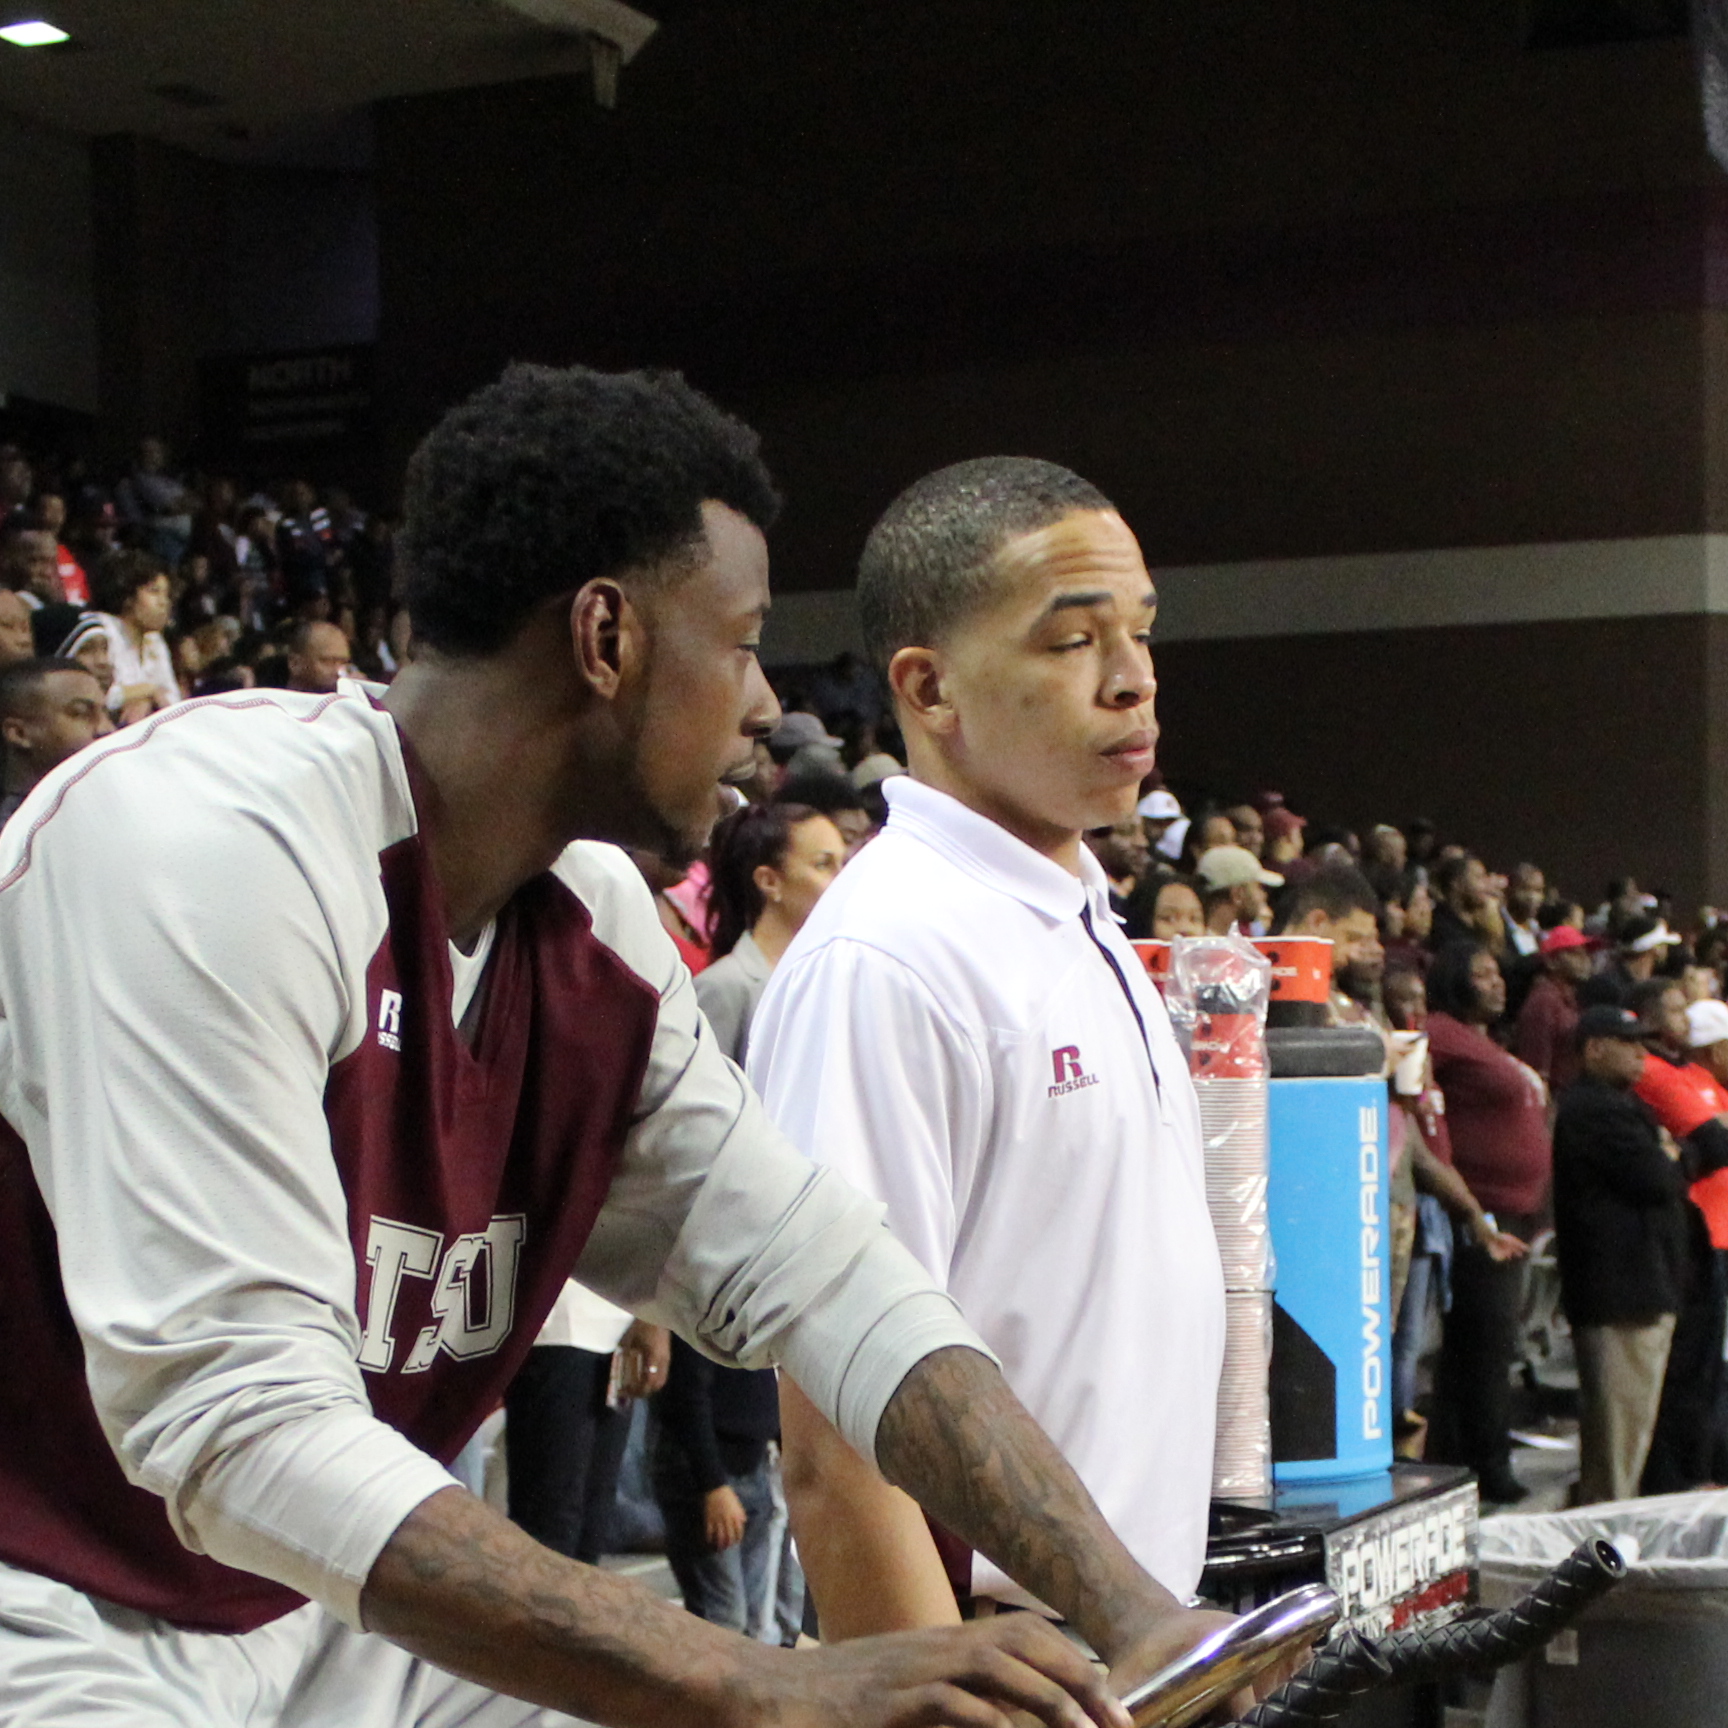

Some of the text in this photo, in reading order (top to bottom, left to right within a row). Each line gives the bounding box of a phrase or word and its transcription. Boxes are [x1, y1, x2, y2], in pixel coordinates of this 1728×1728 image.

[1048, 1073, 1100, 1098] RUSSELL
[1052, 1045, 1083, 1084] R
[356, 1213, 526, 1374] TSU
[1359, 1106, 1383, 1440] POWERADE
[1342, 1503, 1467, 1619] POWERADE
